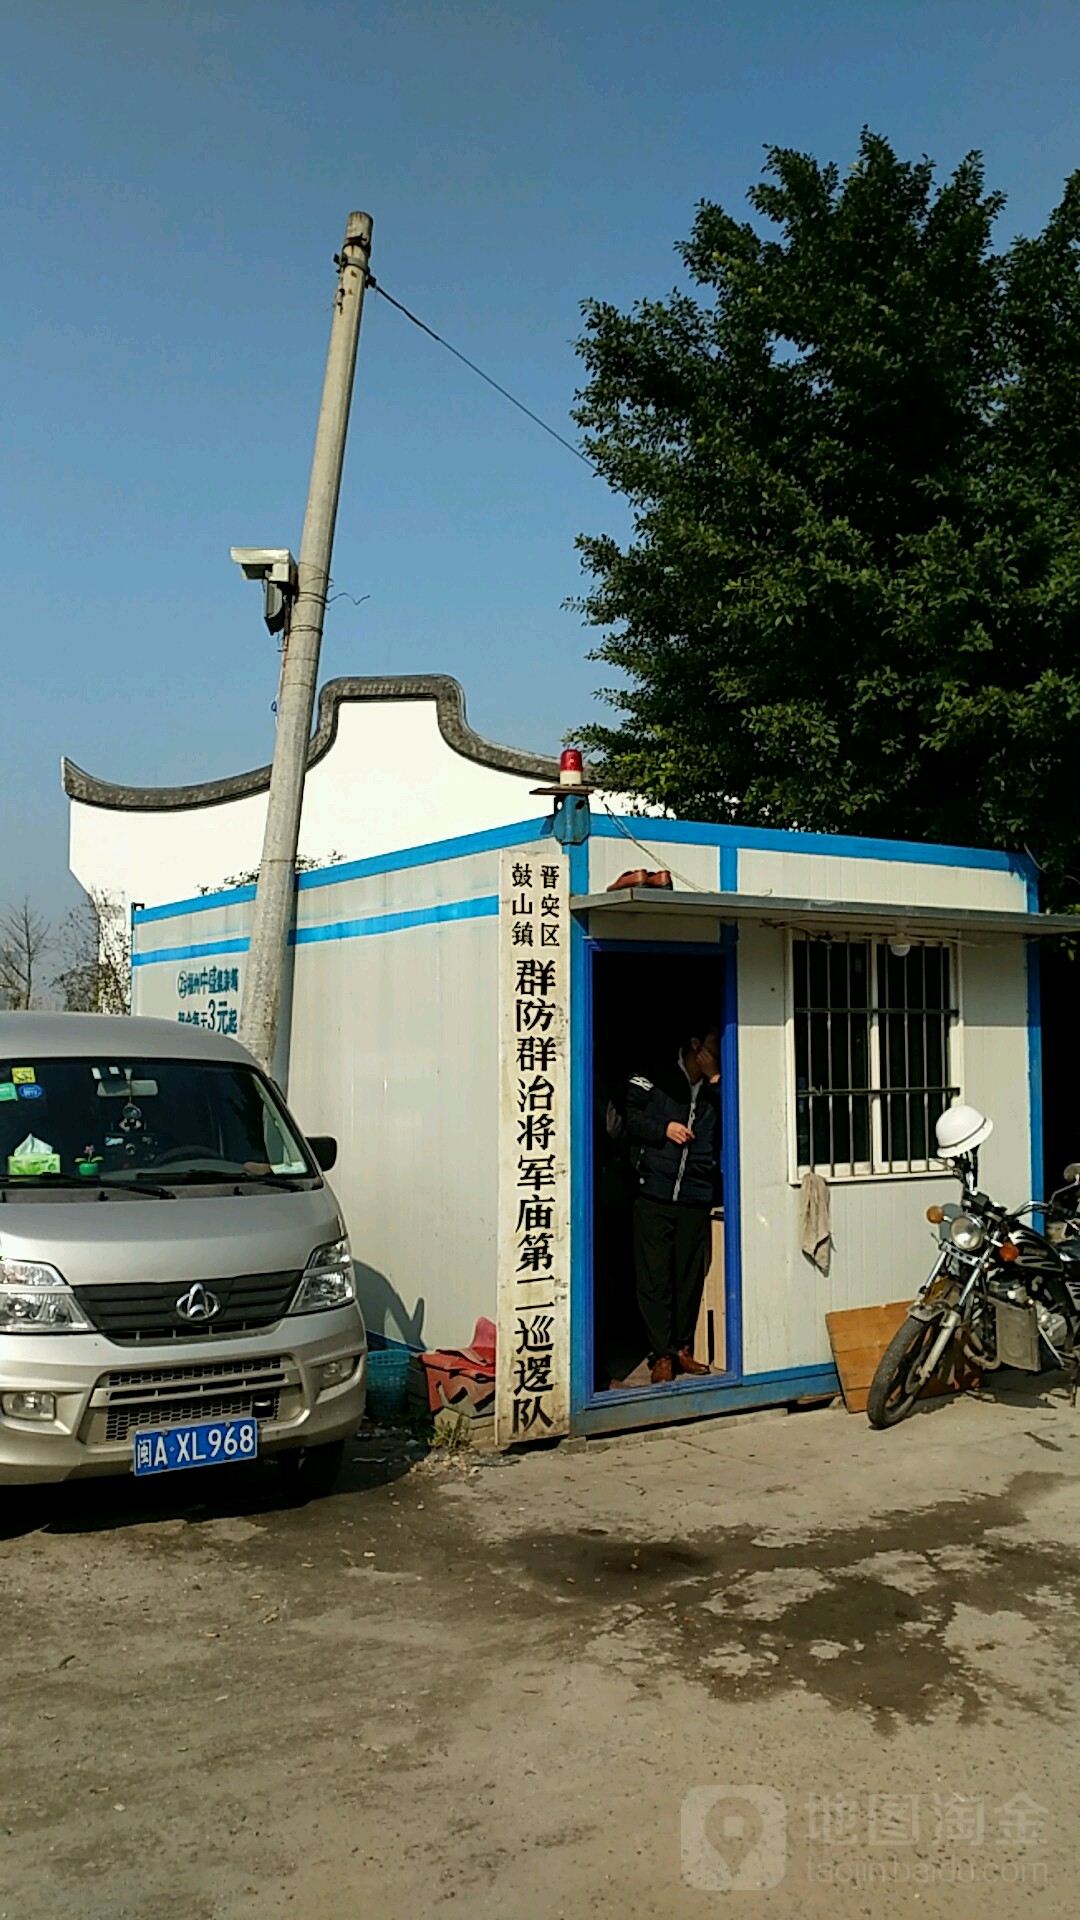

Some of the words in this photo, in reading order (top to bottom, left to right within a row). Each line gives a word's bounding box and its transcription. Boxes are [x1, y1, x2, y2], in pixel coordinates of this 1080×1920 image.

[511, 862, 534, 948] 鼓山镇
[540, 864, 560, 948] 晋安区
[512, 958, 557, 1435] 群防群治将军庙第二巡逻队
